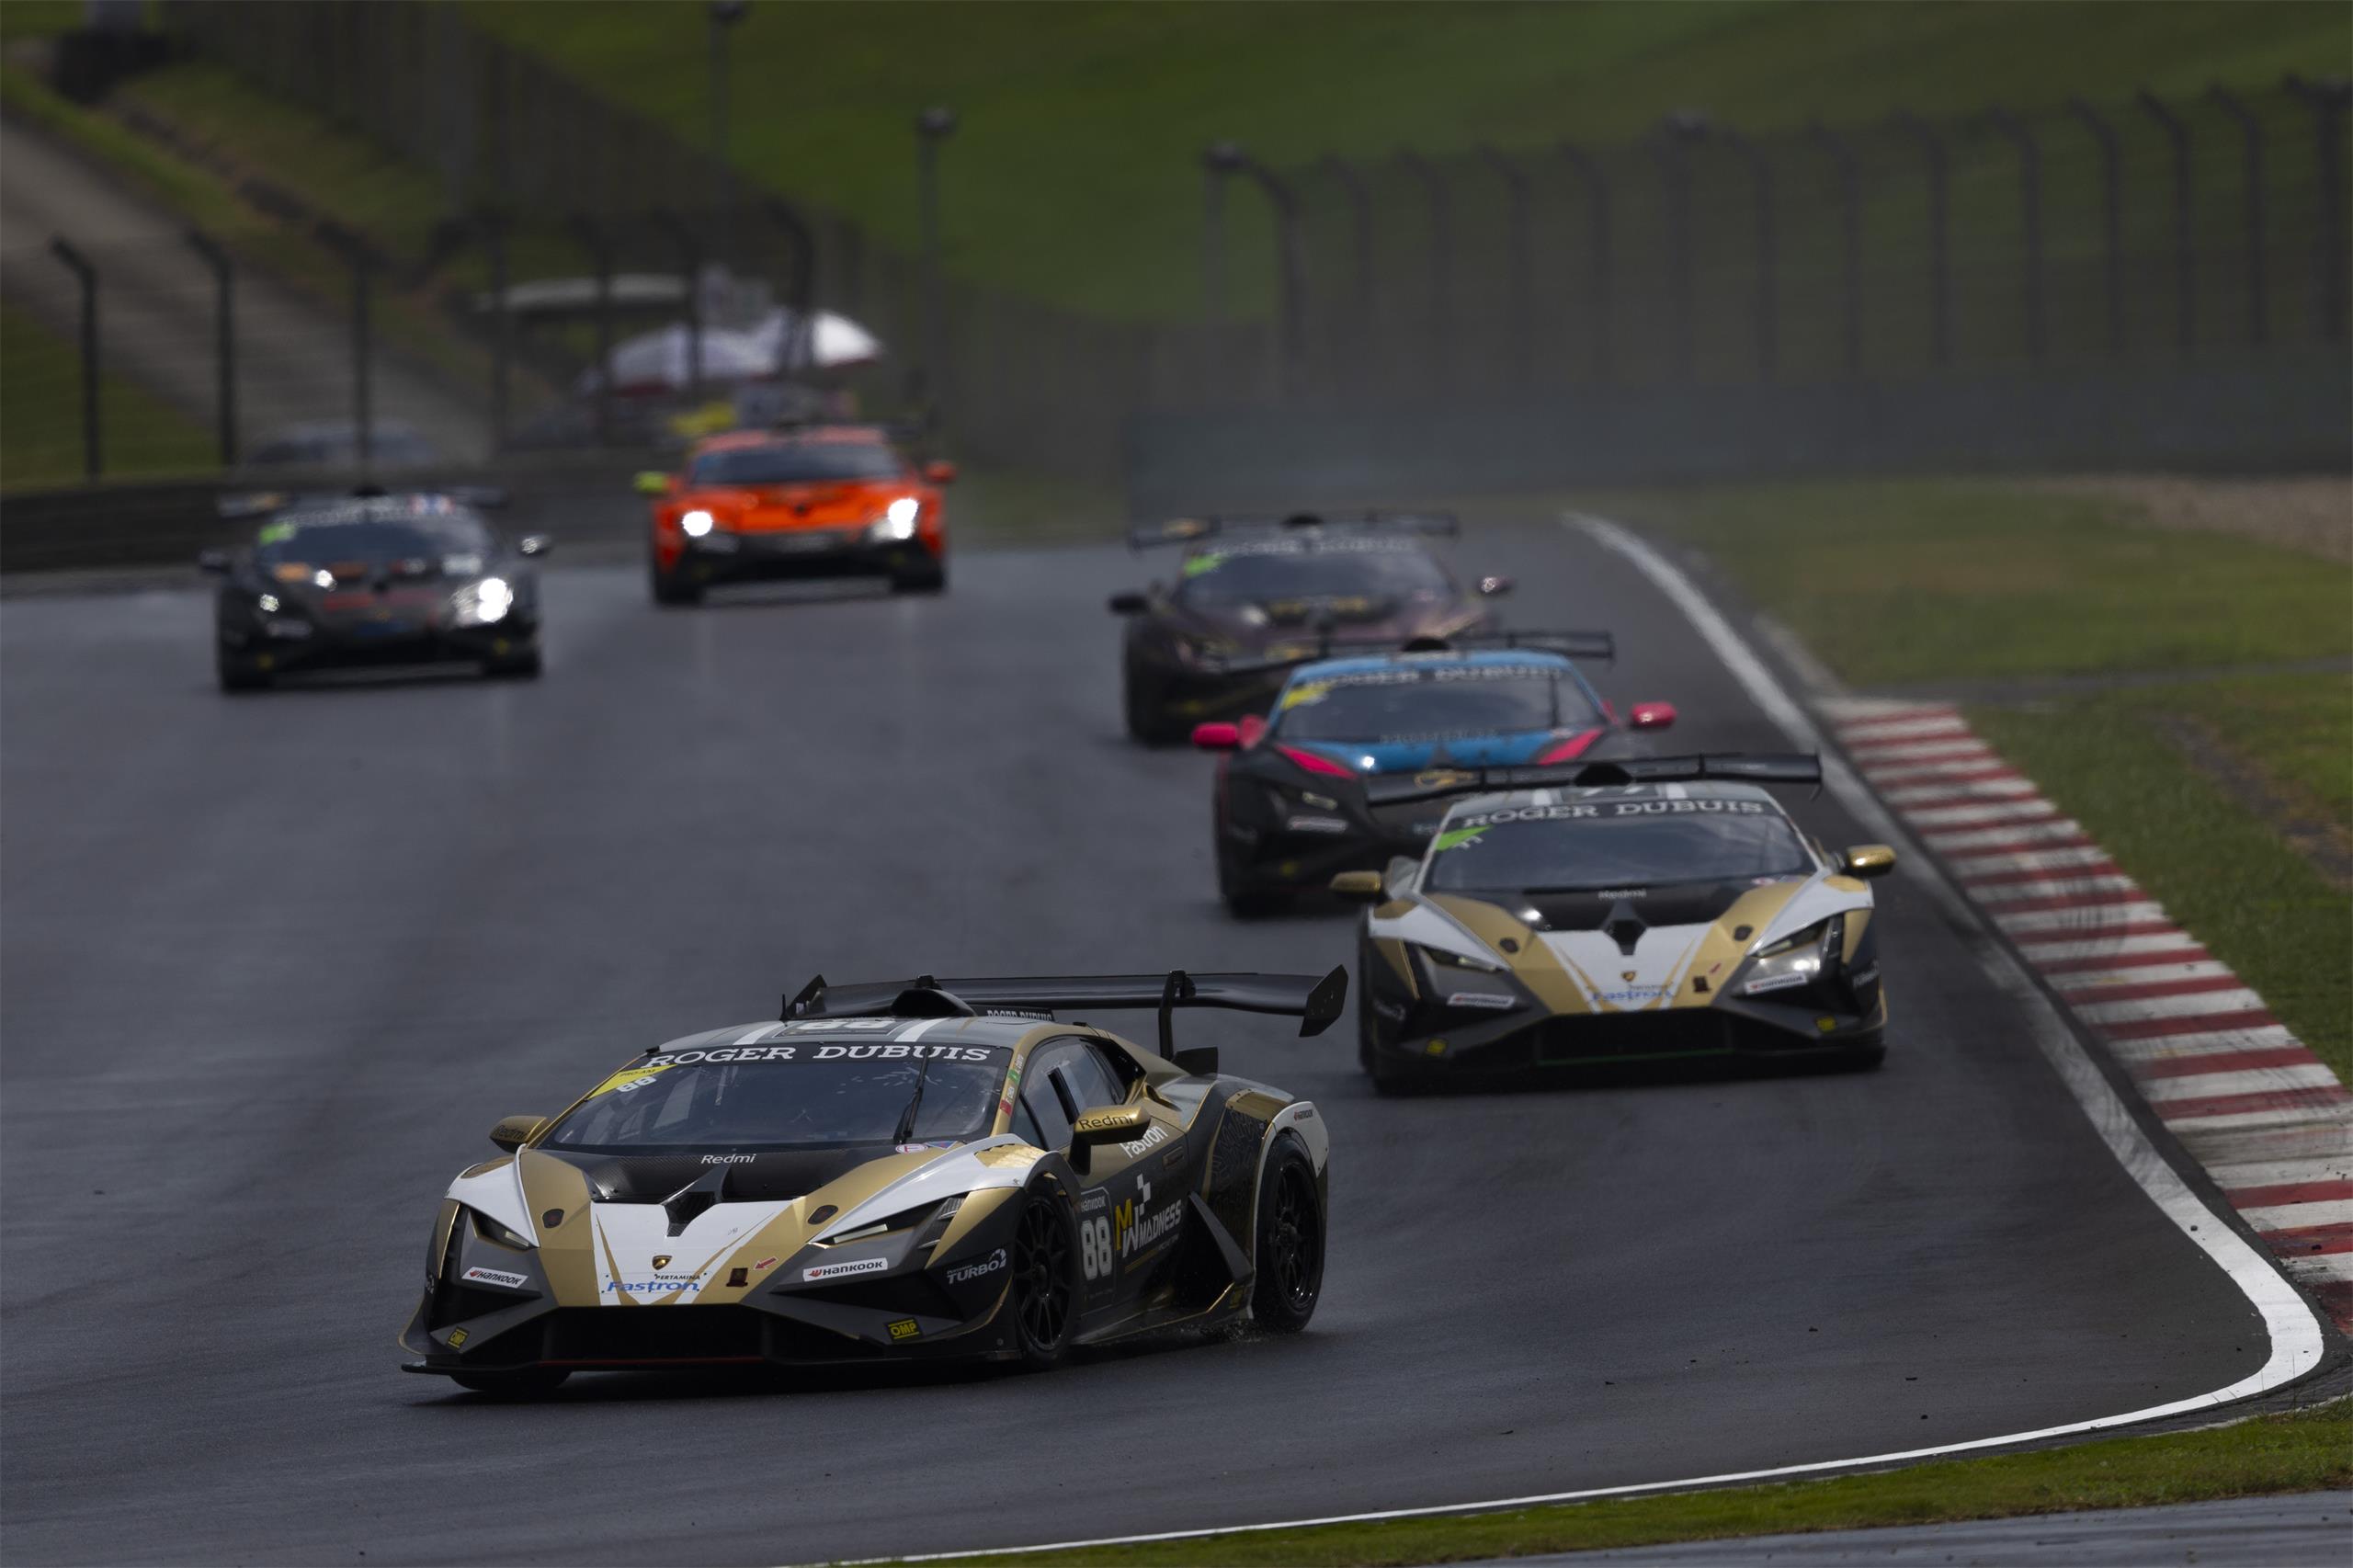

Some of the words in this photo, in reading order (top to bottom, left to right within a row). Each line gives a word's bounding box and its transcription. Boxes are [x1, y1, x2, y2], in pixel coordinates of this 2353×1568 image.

[1463, 805, 1599, 827] ROGER
[1615, 801, 1765, 814] DUBUIS
[640, 1046, 794, 1069] ROGER
[813, 1045, 992, 1062] DUBUIS
[617, 1076, 657, 1093] 88
[1078, 1113, 1134, 1130] Redmi
[701, 1153, 756, 1165] Redmi
[1080, 1215, 1113, 1280] 88
[607, 1280, 699, 1292] Fastron
[890, 1322, 917, 1336] OMP
